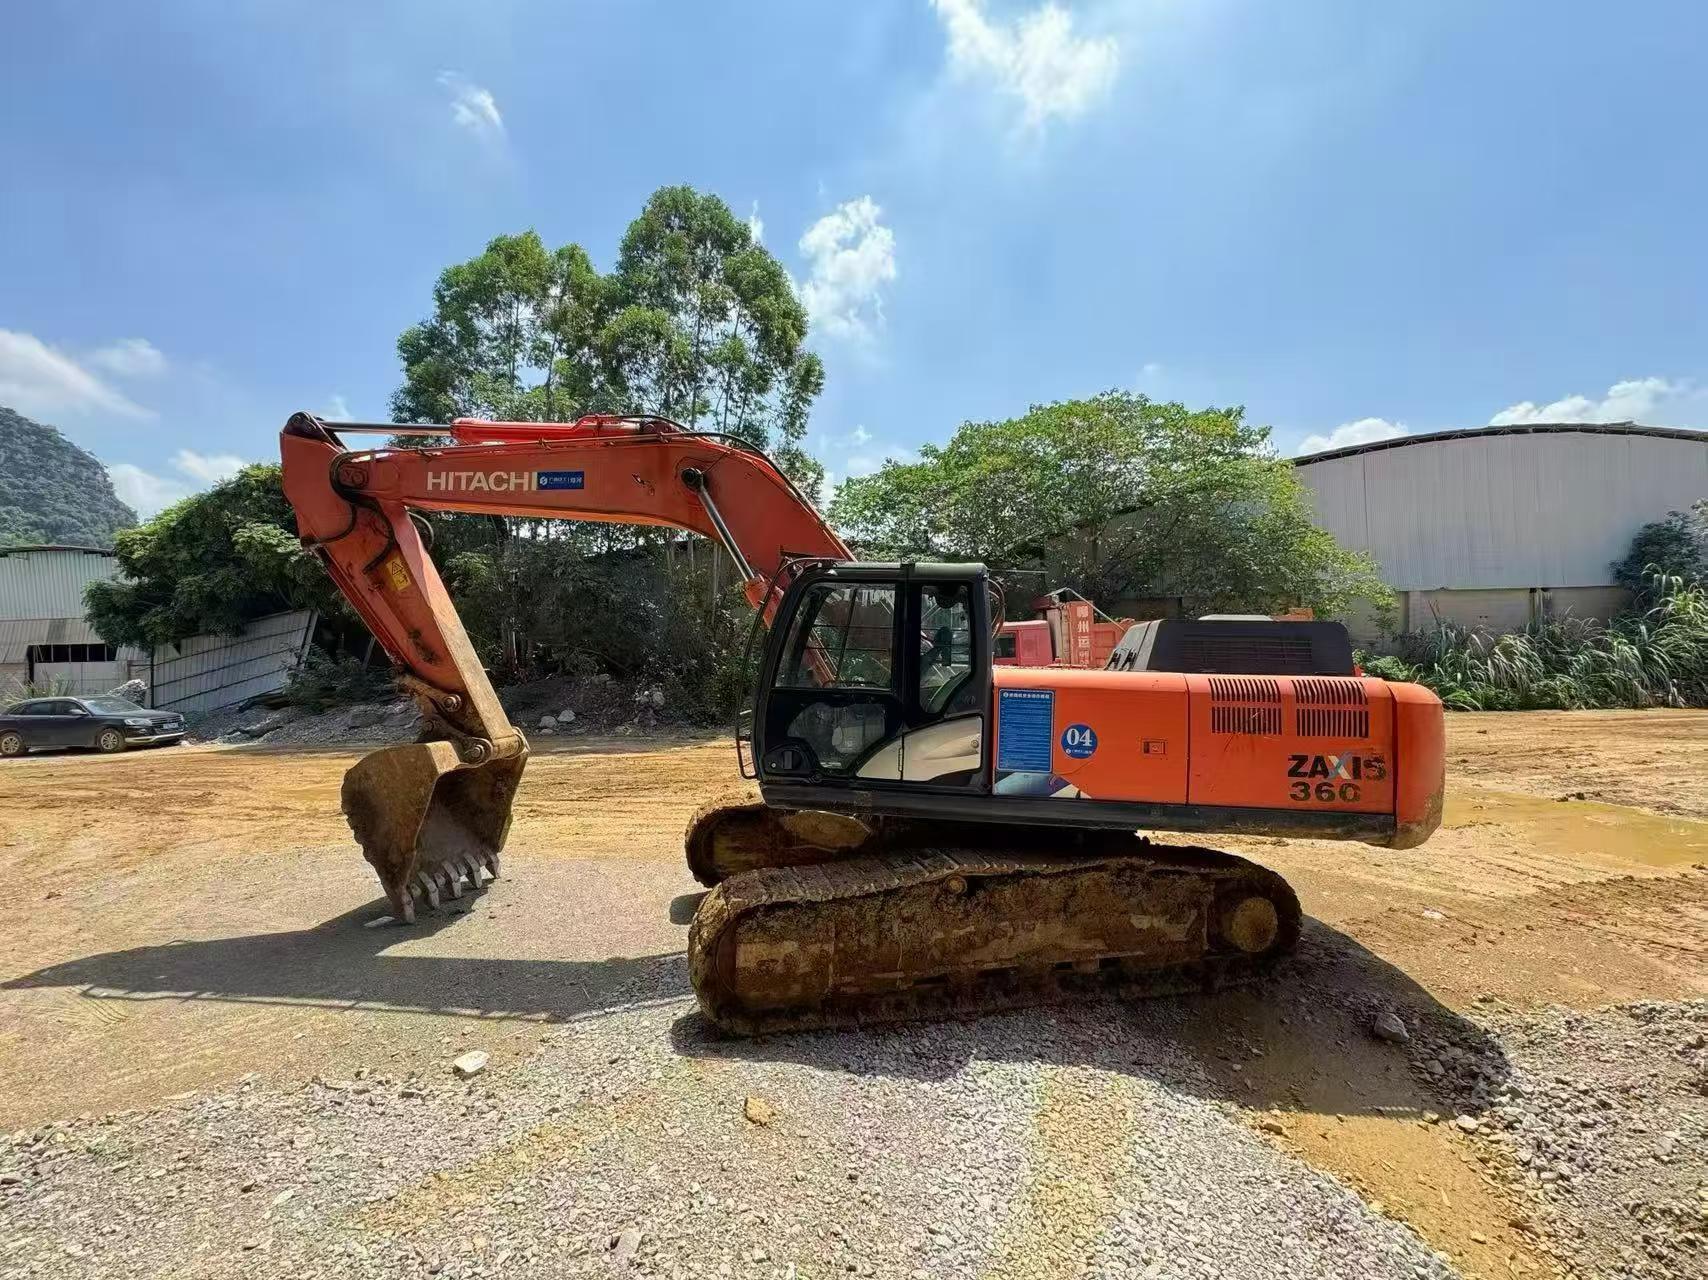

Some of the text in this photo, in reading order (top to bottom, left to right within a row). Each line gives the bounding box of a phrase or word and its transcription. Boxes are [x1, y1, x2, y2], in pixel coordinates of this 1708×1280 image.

[427, 471, 537, 491] HITACHI
[1066, 728, 1093, 747] 04
[1288, 755, 1387, 781] ZAXIS
[1290, 781, 1361, 803] 360
